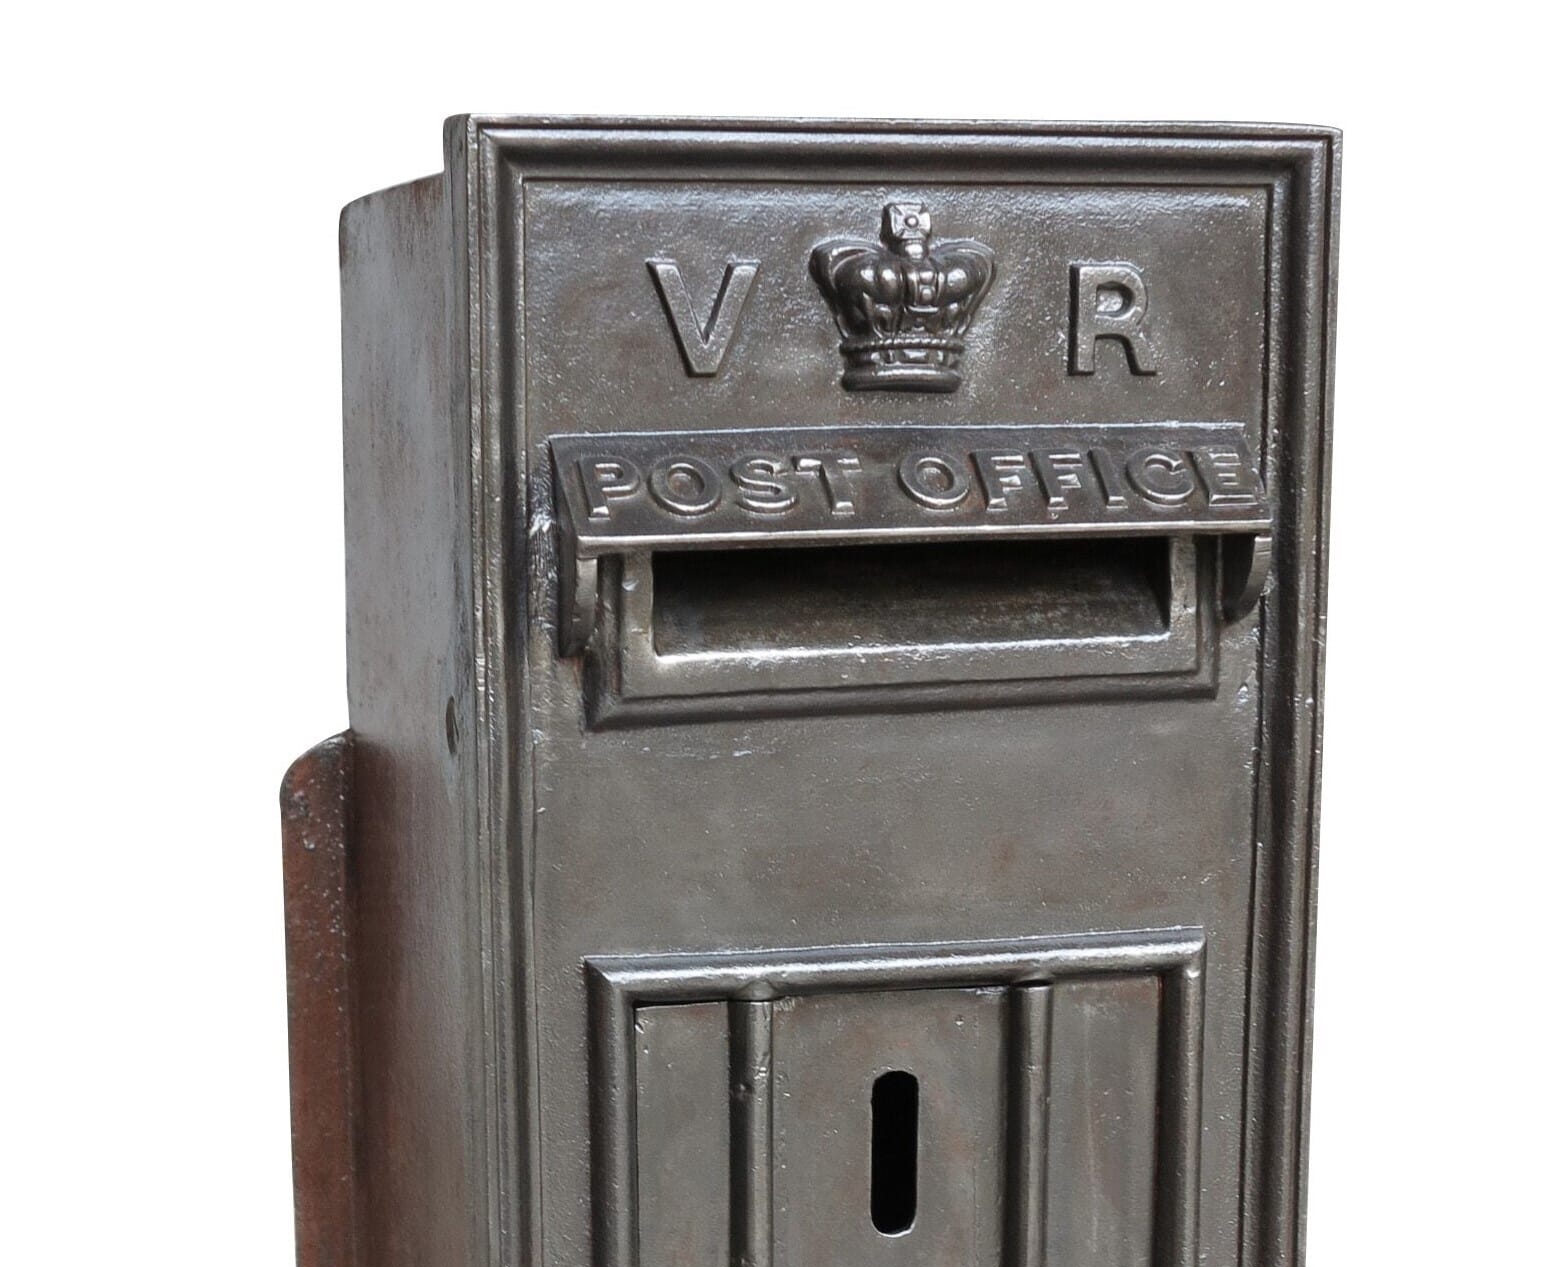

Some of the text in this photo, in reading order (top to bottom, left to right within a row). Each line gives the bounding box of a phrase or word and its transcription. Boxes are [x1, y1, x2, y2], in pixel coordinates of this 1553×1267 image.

[646, 258, 1157, 378] V R
[572, 447, 1262, 523] POST OFFICE
